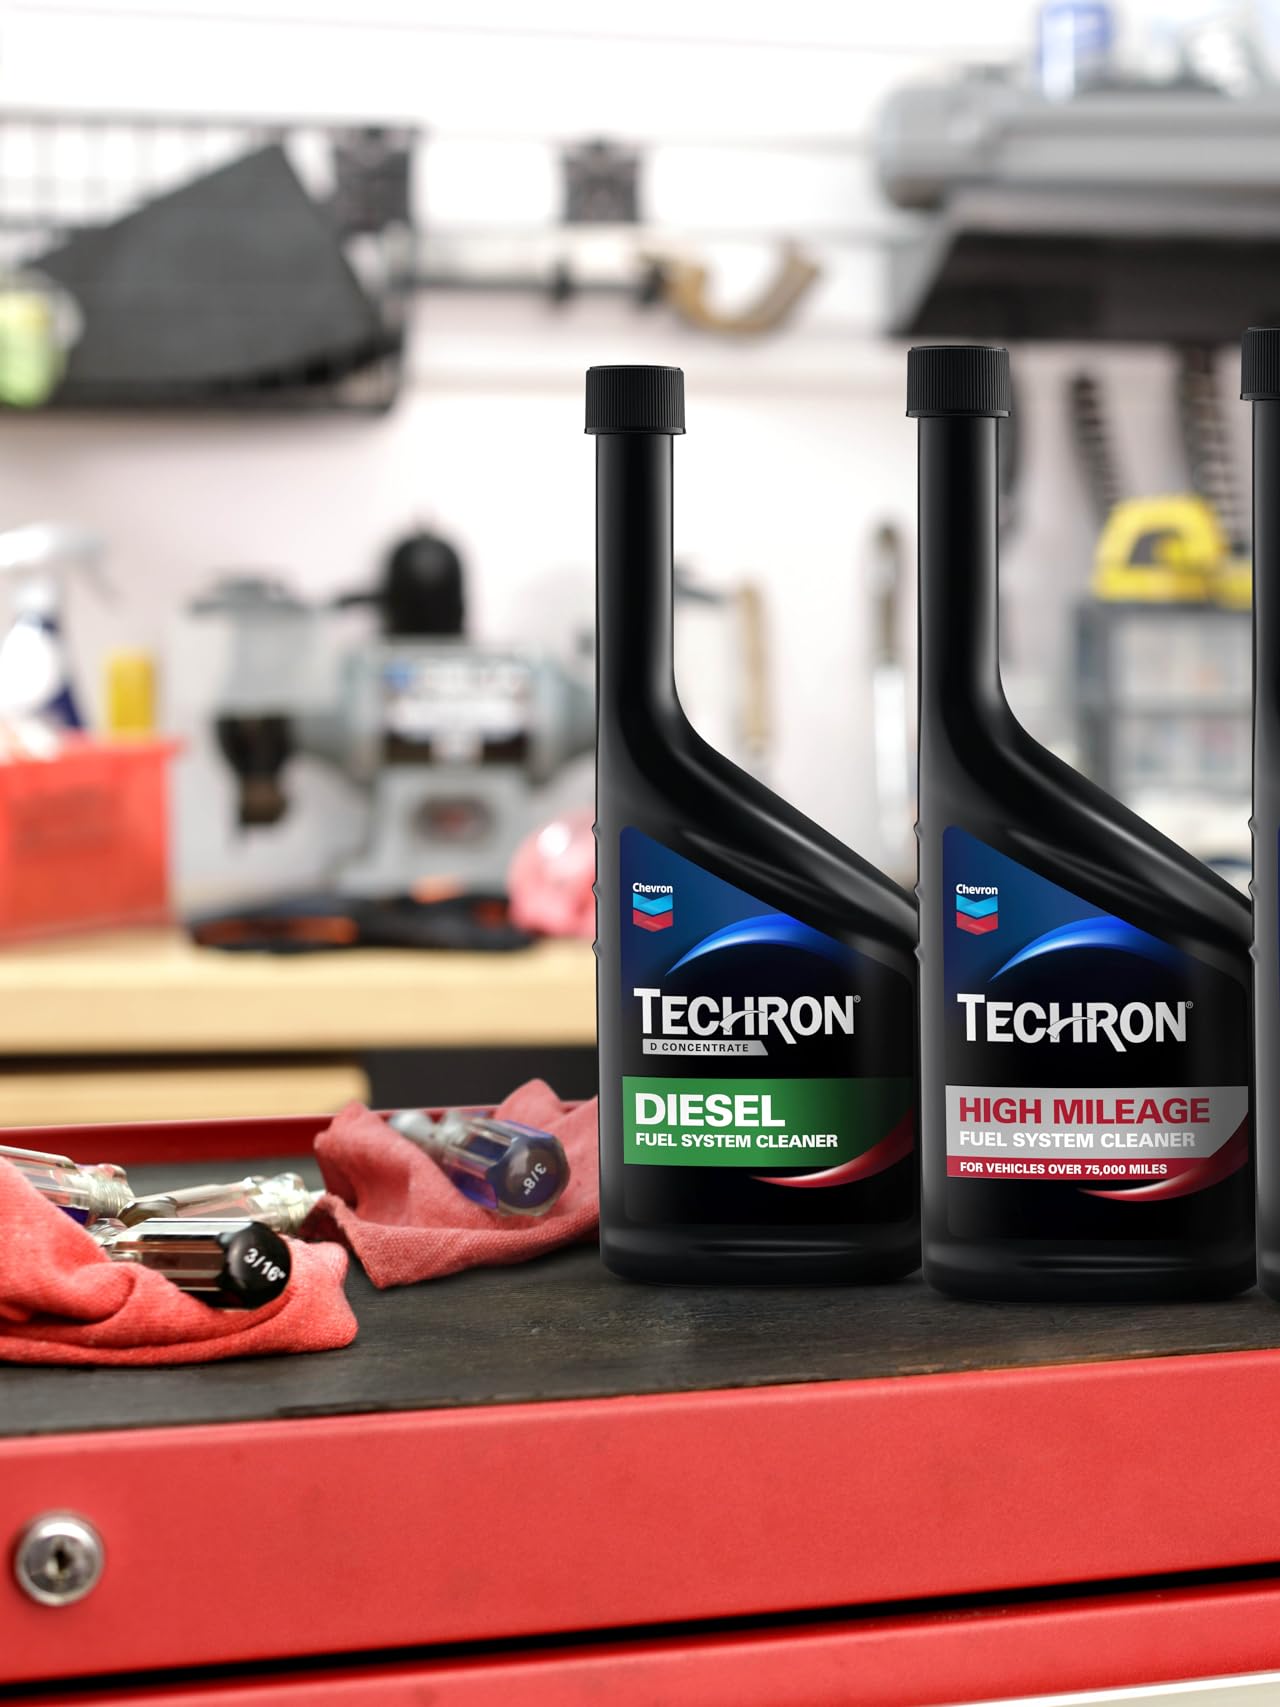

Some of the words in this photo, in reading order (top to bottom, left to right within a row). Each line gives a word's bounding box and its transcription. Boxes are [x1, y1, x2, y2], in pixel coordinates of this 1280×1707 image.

[632, 882, 673, 894] Chevron
[956, 884, 998, 895] Chevron
[650, 1042, 657, 1051] D
[661, 1042, 749, 1053] CONCENTRATE
[635, 1092, 786, 1127] DIESEL
[959, 1097, 1042, 1124] HIGH
[1053, 1098, 1210, 1124] MILEAGE
[635, 1133, 677, 1147] FUEL
[681, 1134, 751, 1148] SYSTEM
[756, 1134, 838, 1148] CLEANER
[959, 1131, 1007, 1147] FUEL
[1013, 1132, 1094, 1148] SYSTEM
[1100, 1133, 1196, 1148] CLEANER
[960, 1162, 984, 1173] FOR
[986, 1162, 1045, 1174] VEHICLES
[1048, 1163, 1082, 1174] OVER
[1085, 1164, 1126, 1177] 75,000
[1129, 1164, 1167, 1175] MILES
[243, 1247, 287, 1282] 3/16"
